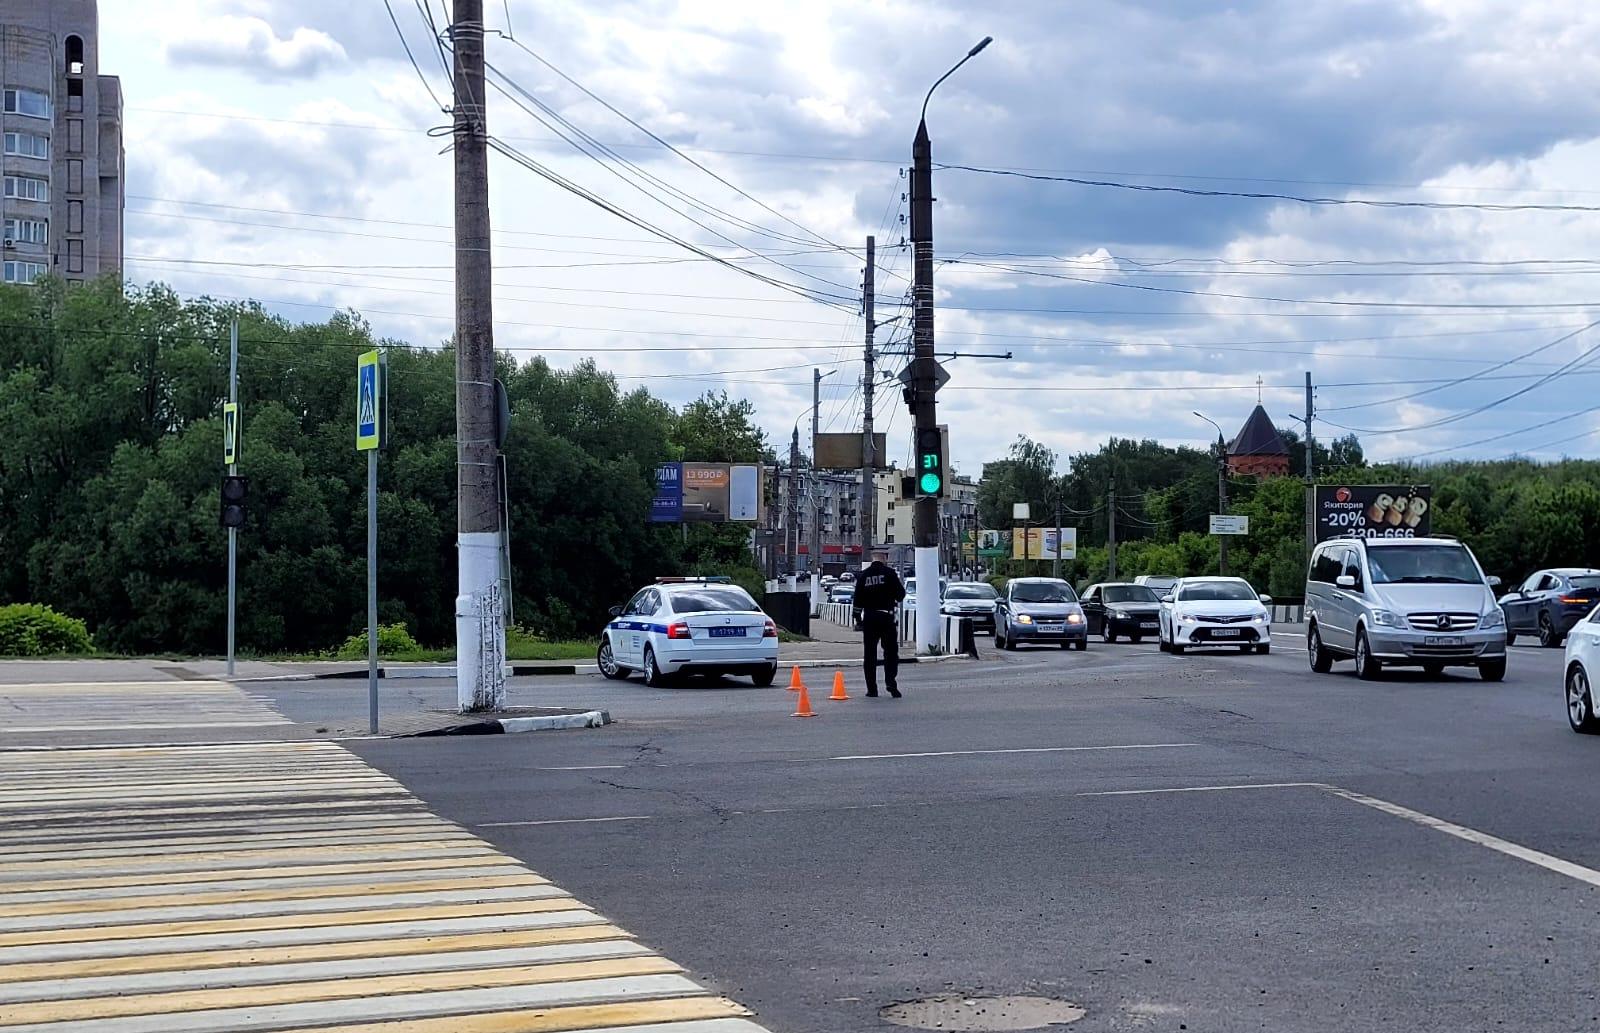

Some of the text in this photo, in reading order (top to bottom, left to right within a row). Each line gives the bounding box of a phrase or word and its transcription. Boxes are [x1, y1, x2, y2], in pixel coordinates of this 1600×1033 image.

[924, 454, 938, 468] 37
[1323, 501, 1364, 511] Якитория
[1321, 510, 1366, 527] -20%
[864, 574, 886, 587] ДПС
